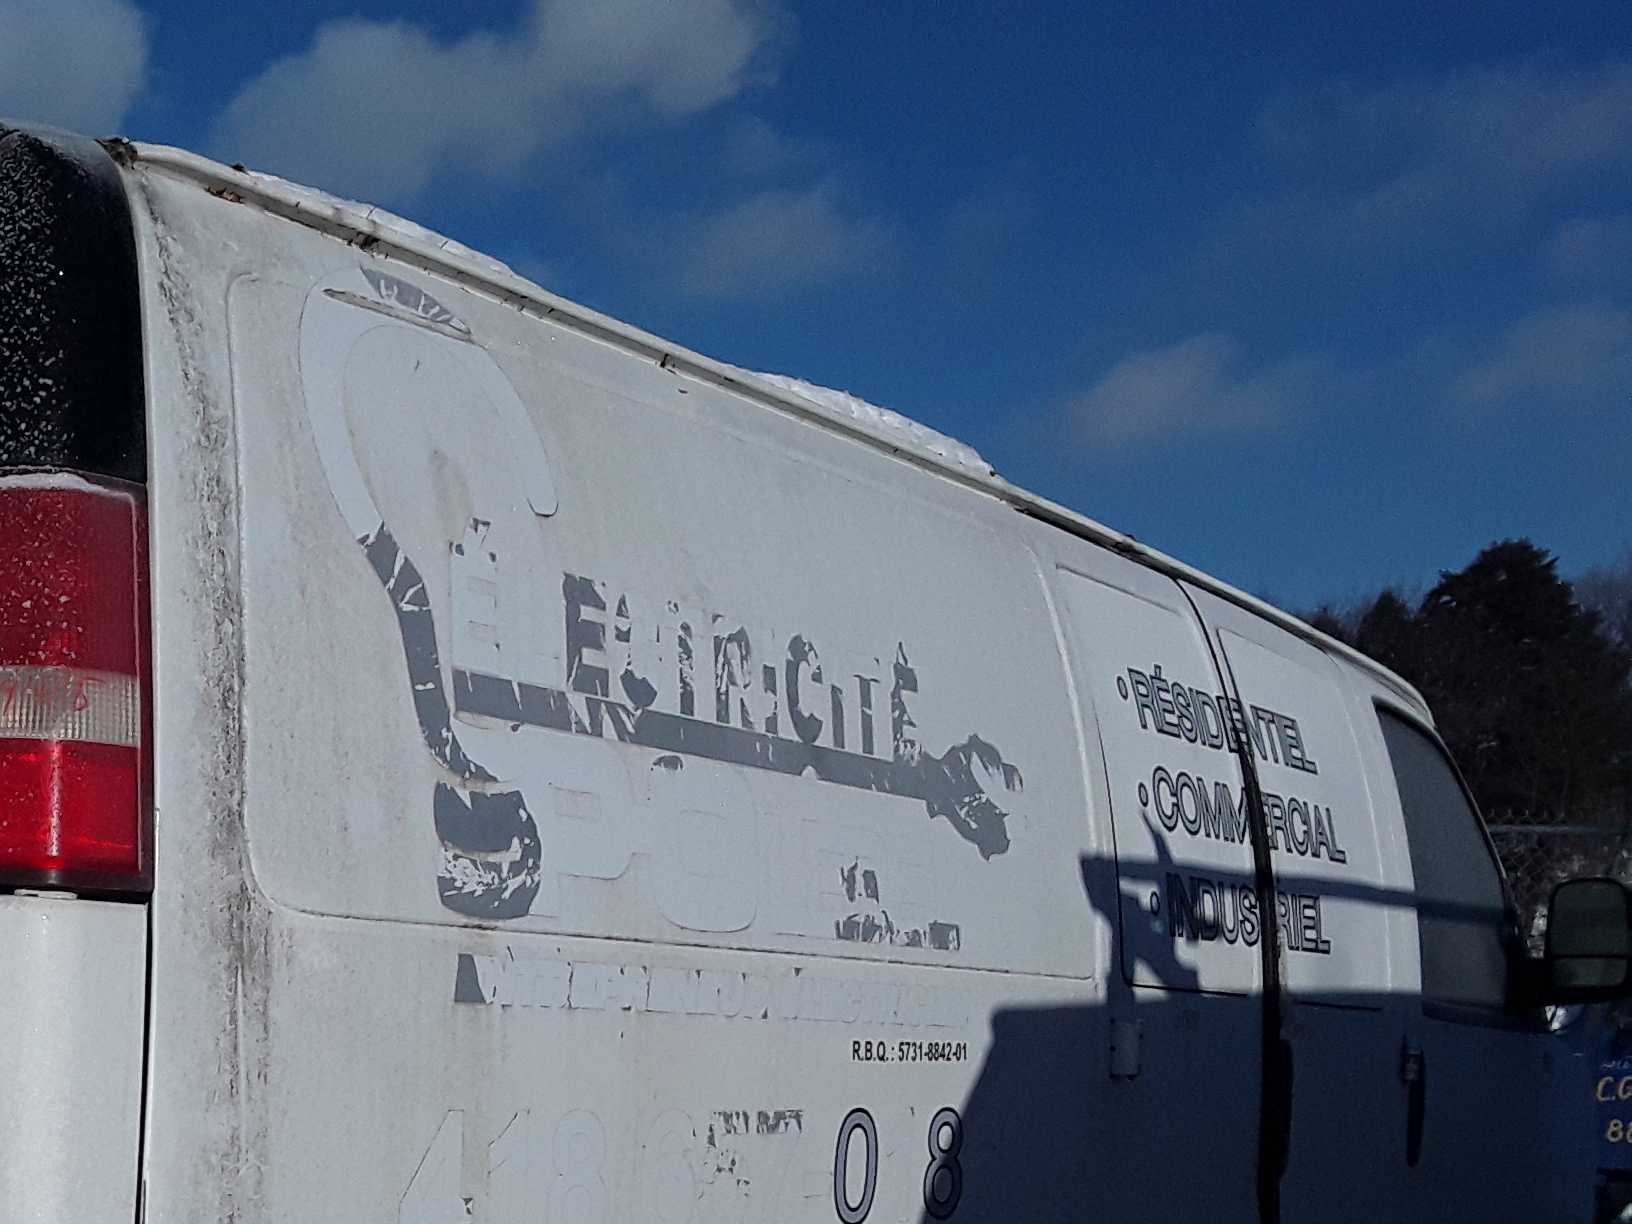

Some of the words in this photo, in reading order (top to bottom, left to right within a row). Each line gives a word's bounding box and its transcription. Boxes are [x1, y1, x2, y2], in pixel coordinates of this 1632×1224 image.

[1127, 664, 1318, 775] RÉSIDENTIEL
[1152, 766, 1347, 864] COMMRCIAL
[1166, 872, 1331, 954] INDUSRIEL
